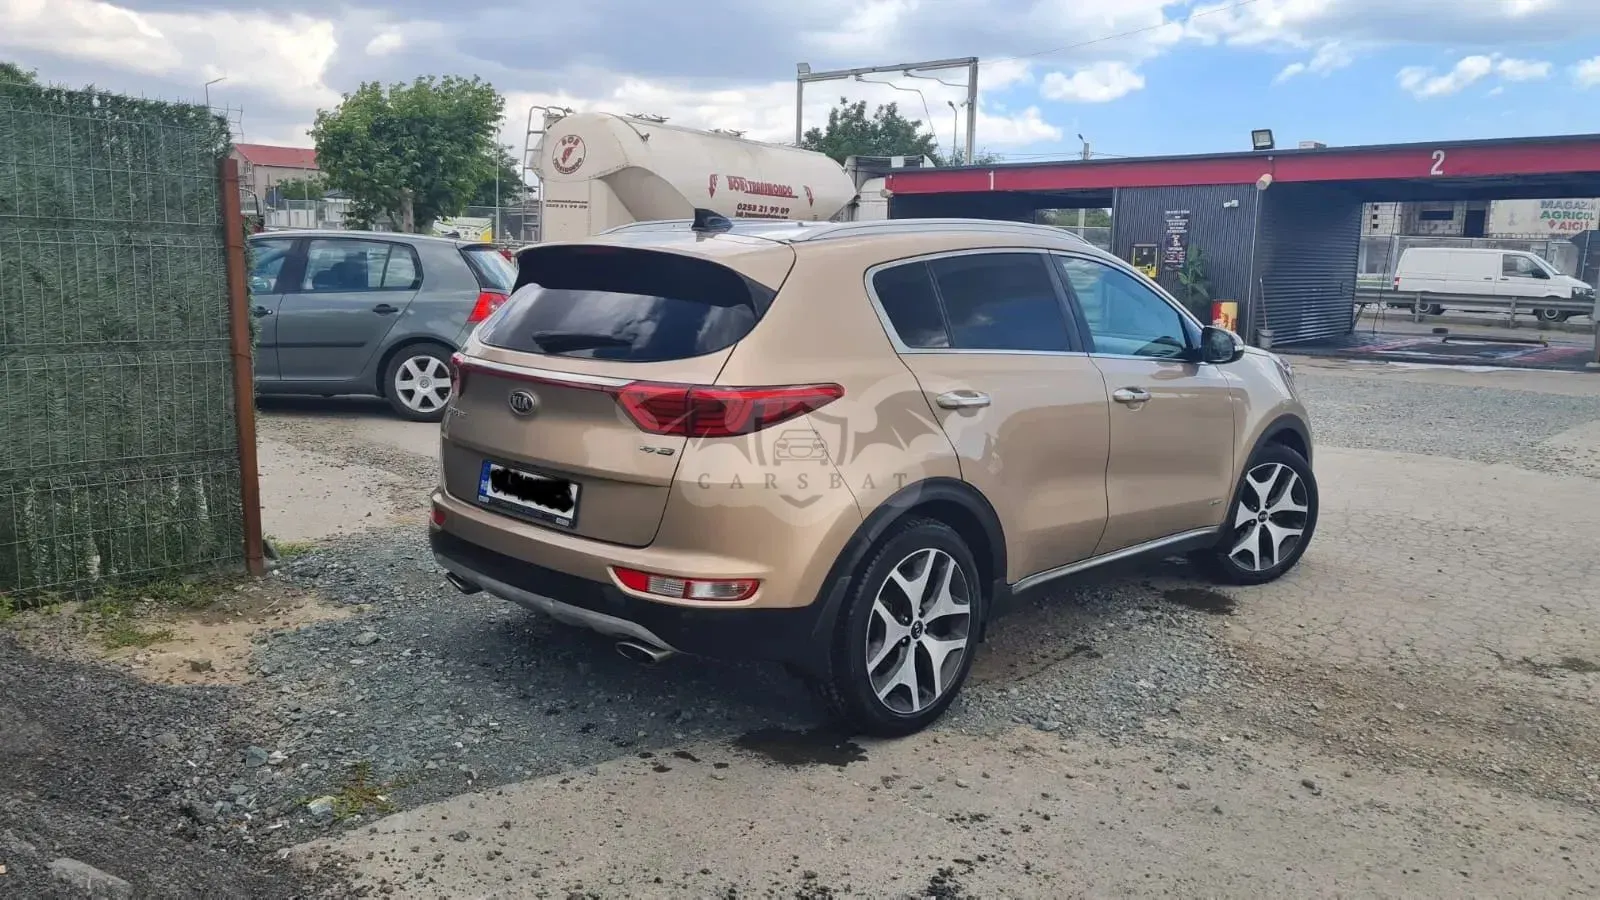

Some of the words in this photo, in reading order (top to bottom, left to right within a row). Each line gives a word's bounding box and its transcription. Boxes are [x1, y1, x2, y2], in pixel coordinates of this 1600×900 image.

[1430, 150, 1445, 175] 2
[988, 171, 995, 190] 1
[737, 203, 758, 212] 0253
[758, 205, 768, 213] 21
[770, 206, 779, 214] 99
[780, 207, 790, 215] 09
[1540, 210, 1595, 220] AGRICOL
[1559, 221, 1583, 230] AICI
